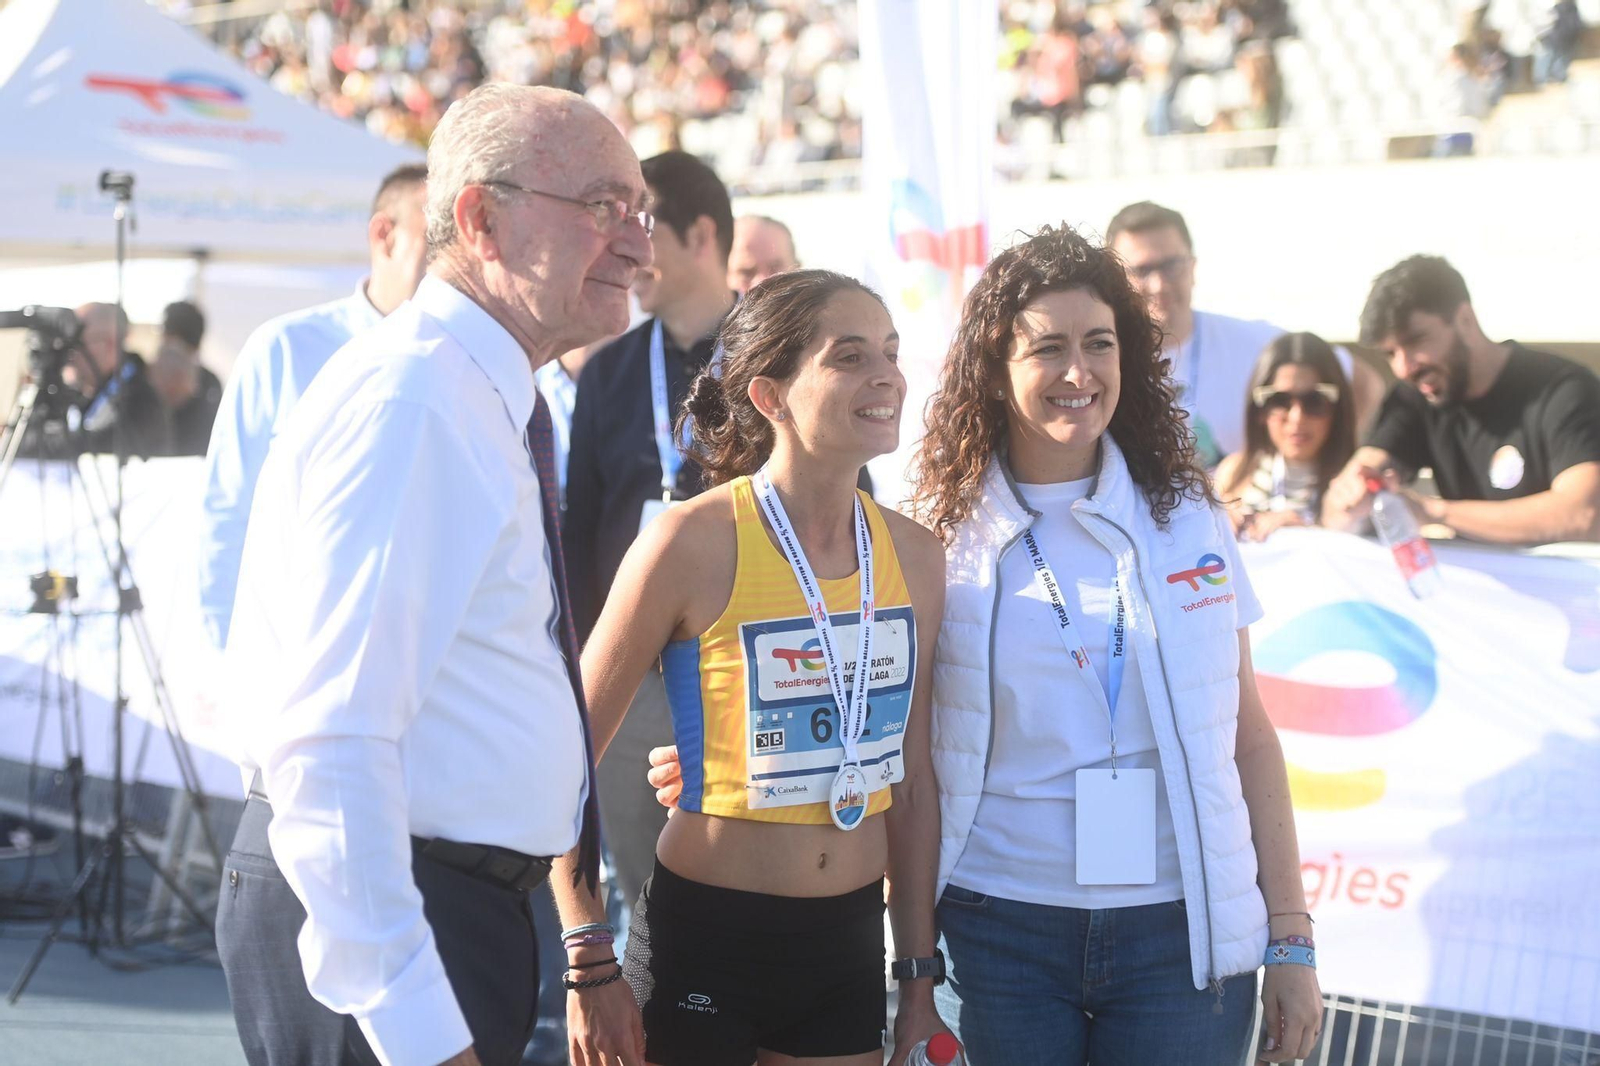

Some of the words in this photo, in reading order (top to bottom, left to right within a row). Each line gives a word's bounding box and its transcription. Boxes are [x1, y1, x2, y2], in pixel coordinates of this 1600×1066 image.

[1033, 556, 1046, 571] 1/2
[1042, 571, 1070, 629] TotalEnergies
[1181, 592, 1234, 613] TotalEnergie
[871, 655, 894, 668] RATÓN
[843, 674, 854, 683] DE
[869, 670, 889, 681] LAGA
[891, 667, 905, 678] 2022
[777, 785, 808, 794] CaixaBank
[678, 1001, 718, 1014] Kalenji
